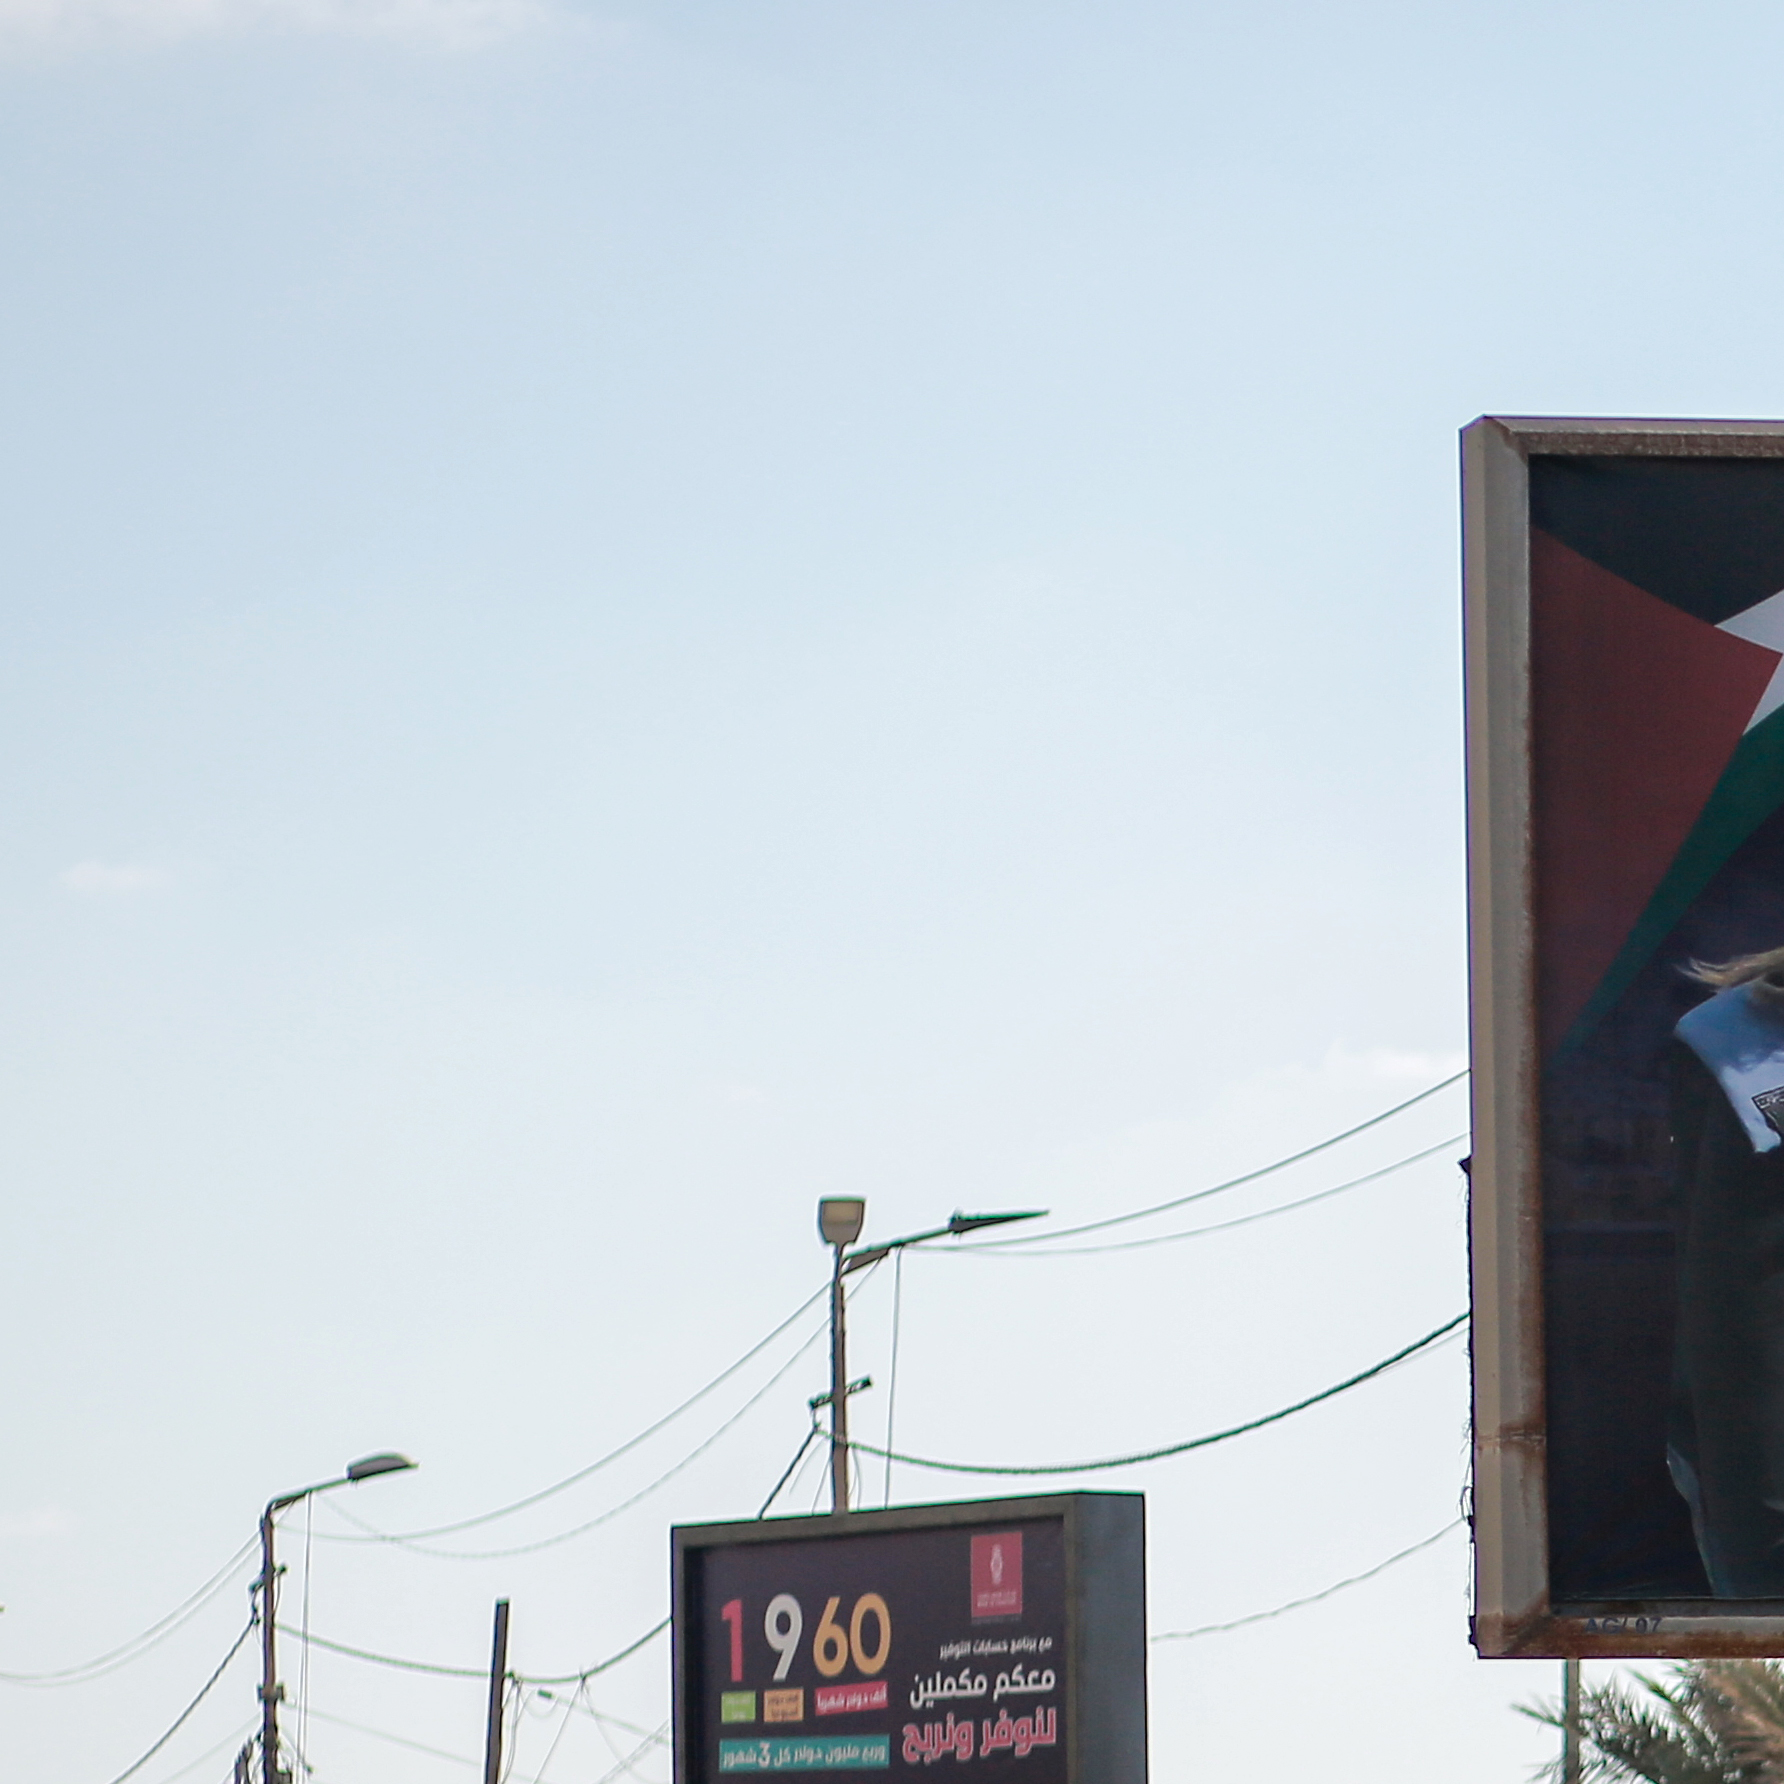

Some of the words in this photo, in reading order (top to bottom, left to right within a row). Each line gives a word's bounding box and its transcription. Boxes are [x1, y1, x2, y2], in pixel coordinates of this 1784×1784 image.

[939, 1639, 971, 1661] التوفير
[972, 1637, 1009, 1657] حسابات
[1010, 1636, 1037, 1655] برنامج
[909, 1667, 988, 1710] مكملين
[993, 1663, 1056, 1703] معكم
[902, 1712, 974, 1764] ونربح
[980, 1705, 1057, 1758] لنوفر
[757, 1740, 771, 1768] 3
[773, 1746, 792, 1767] كل
